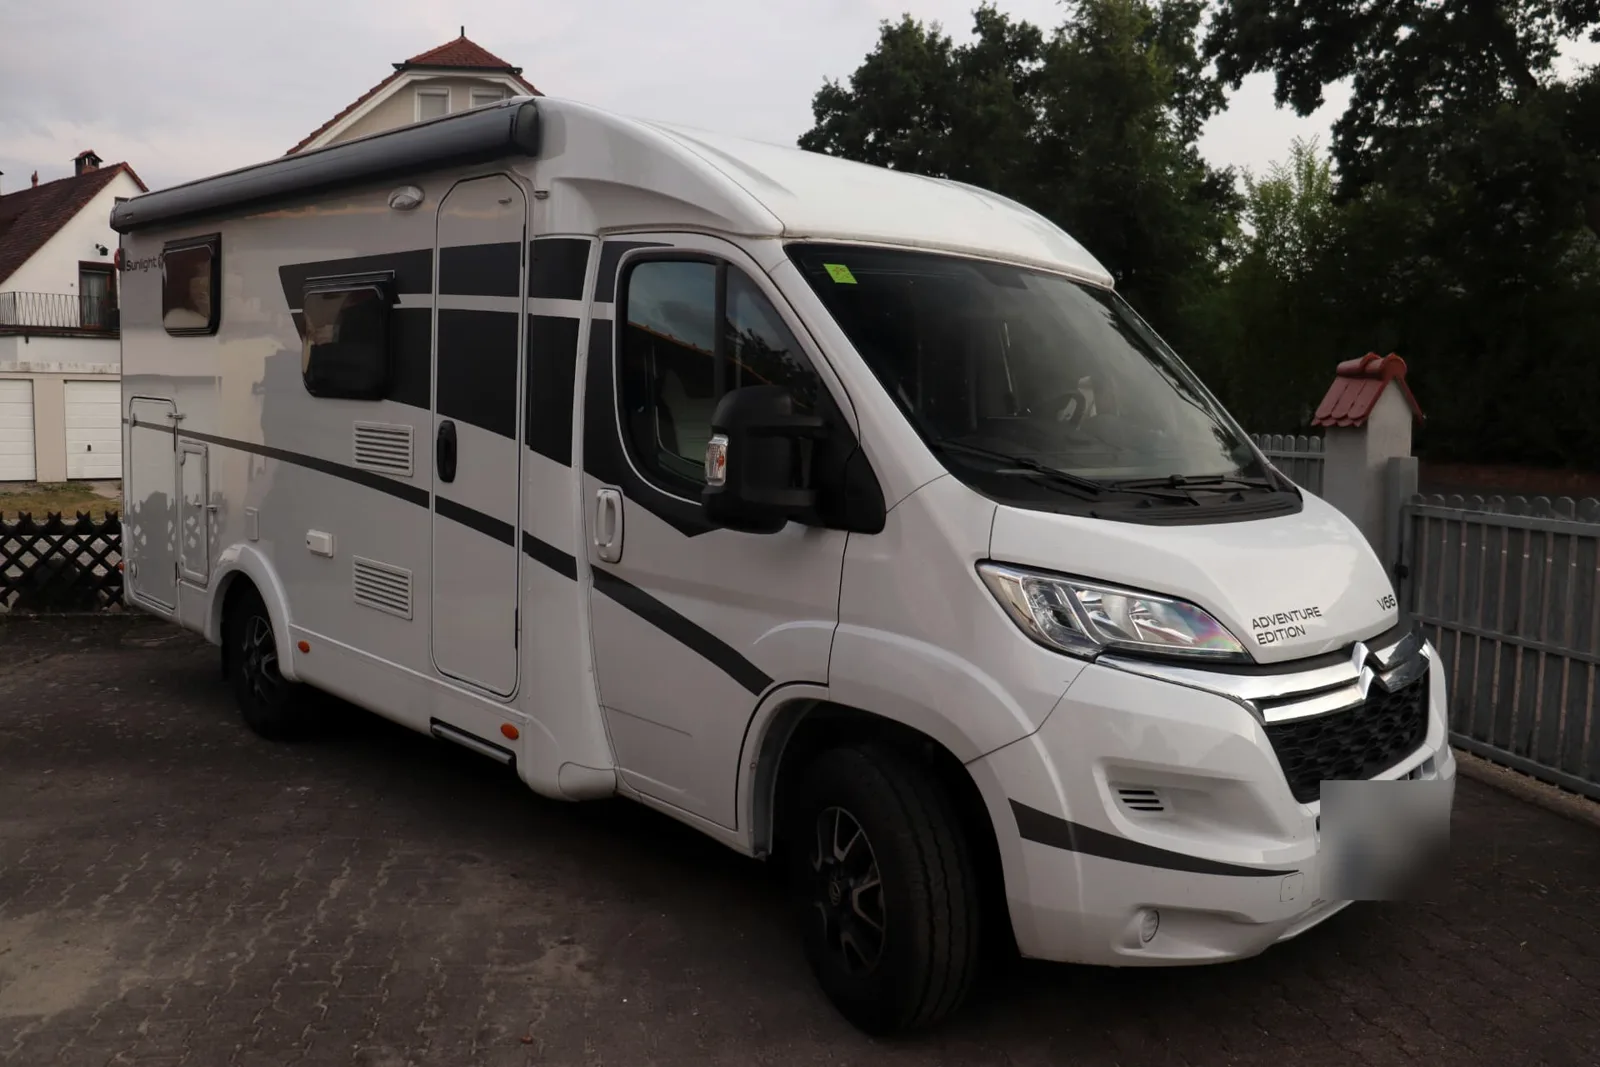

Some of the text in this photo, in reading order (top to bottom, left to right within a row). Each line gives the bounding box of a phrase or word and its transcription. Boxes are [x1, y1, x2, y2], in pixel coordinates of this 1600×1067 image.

[126, 257, 157, 272] Sunlight
[1376, 594, 1396, 611] V66
[1252, 606, 1322, 629] ADVENTURE
[1256, 625, 1306, 645] EDITION
